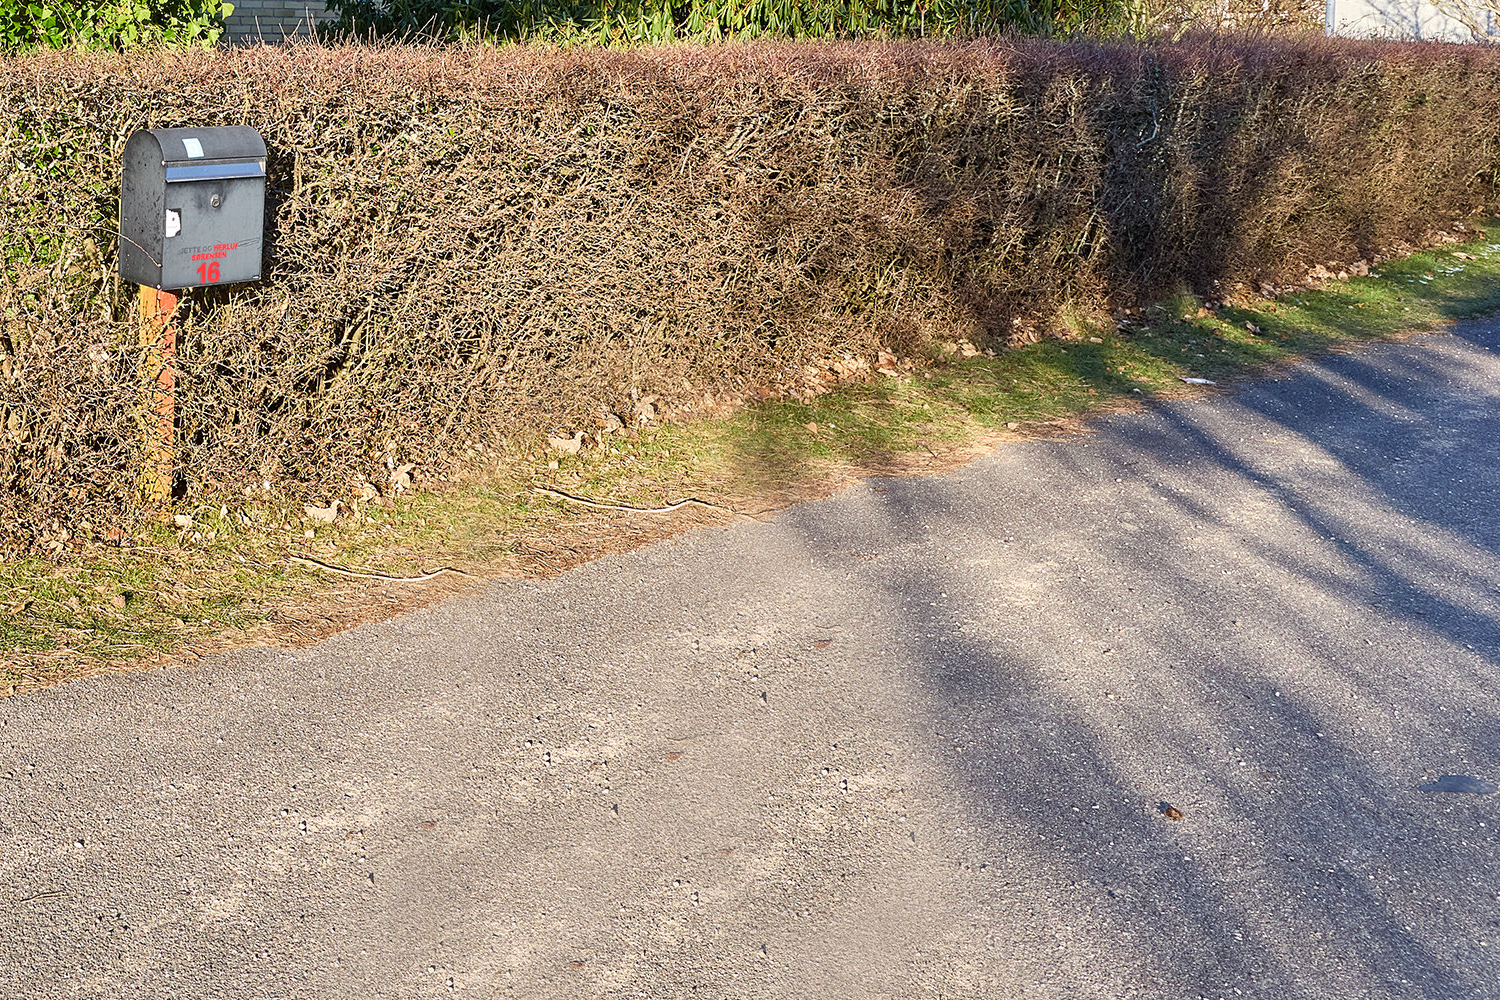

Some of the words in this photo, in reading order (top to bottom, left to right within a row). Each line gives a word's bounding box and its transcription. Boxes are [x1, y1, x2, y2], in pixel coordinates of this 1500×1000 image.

[181, 246, 201, 254] JETTE
[213, 242, 239, 251] HERLUF
[192, 251, 227, 261] SØRENSEN
[196, 261, 220, 284] 16
